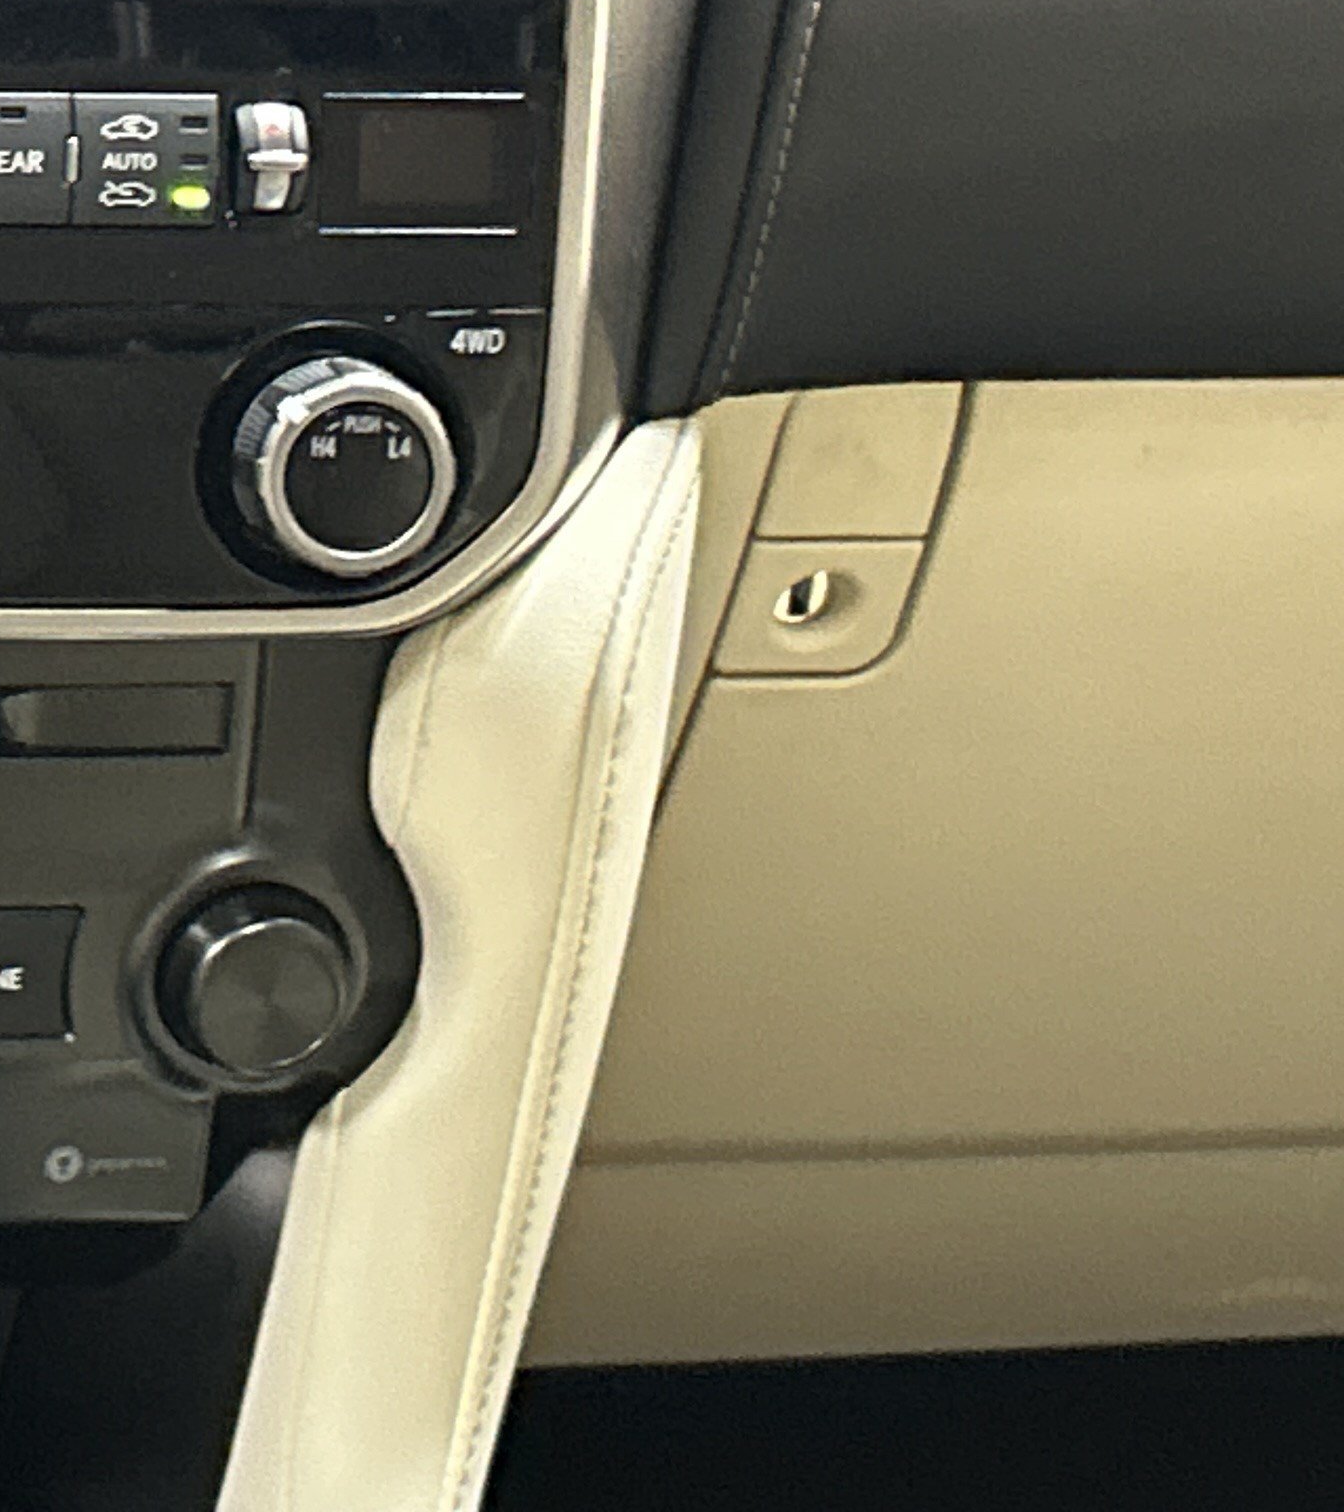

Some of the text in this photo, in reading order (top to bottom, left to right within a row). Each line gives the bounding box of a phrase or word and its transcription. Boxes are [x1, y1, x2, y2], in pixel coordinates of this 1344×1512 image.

[101, 152, 158, 171] AUTO
[450, 328, 505, 354] 4WD
[387, 434, 412, 460] L4
